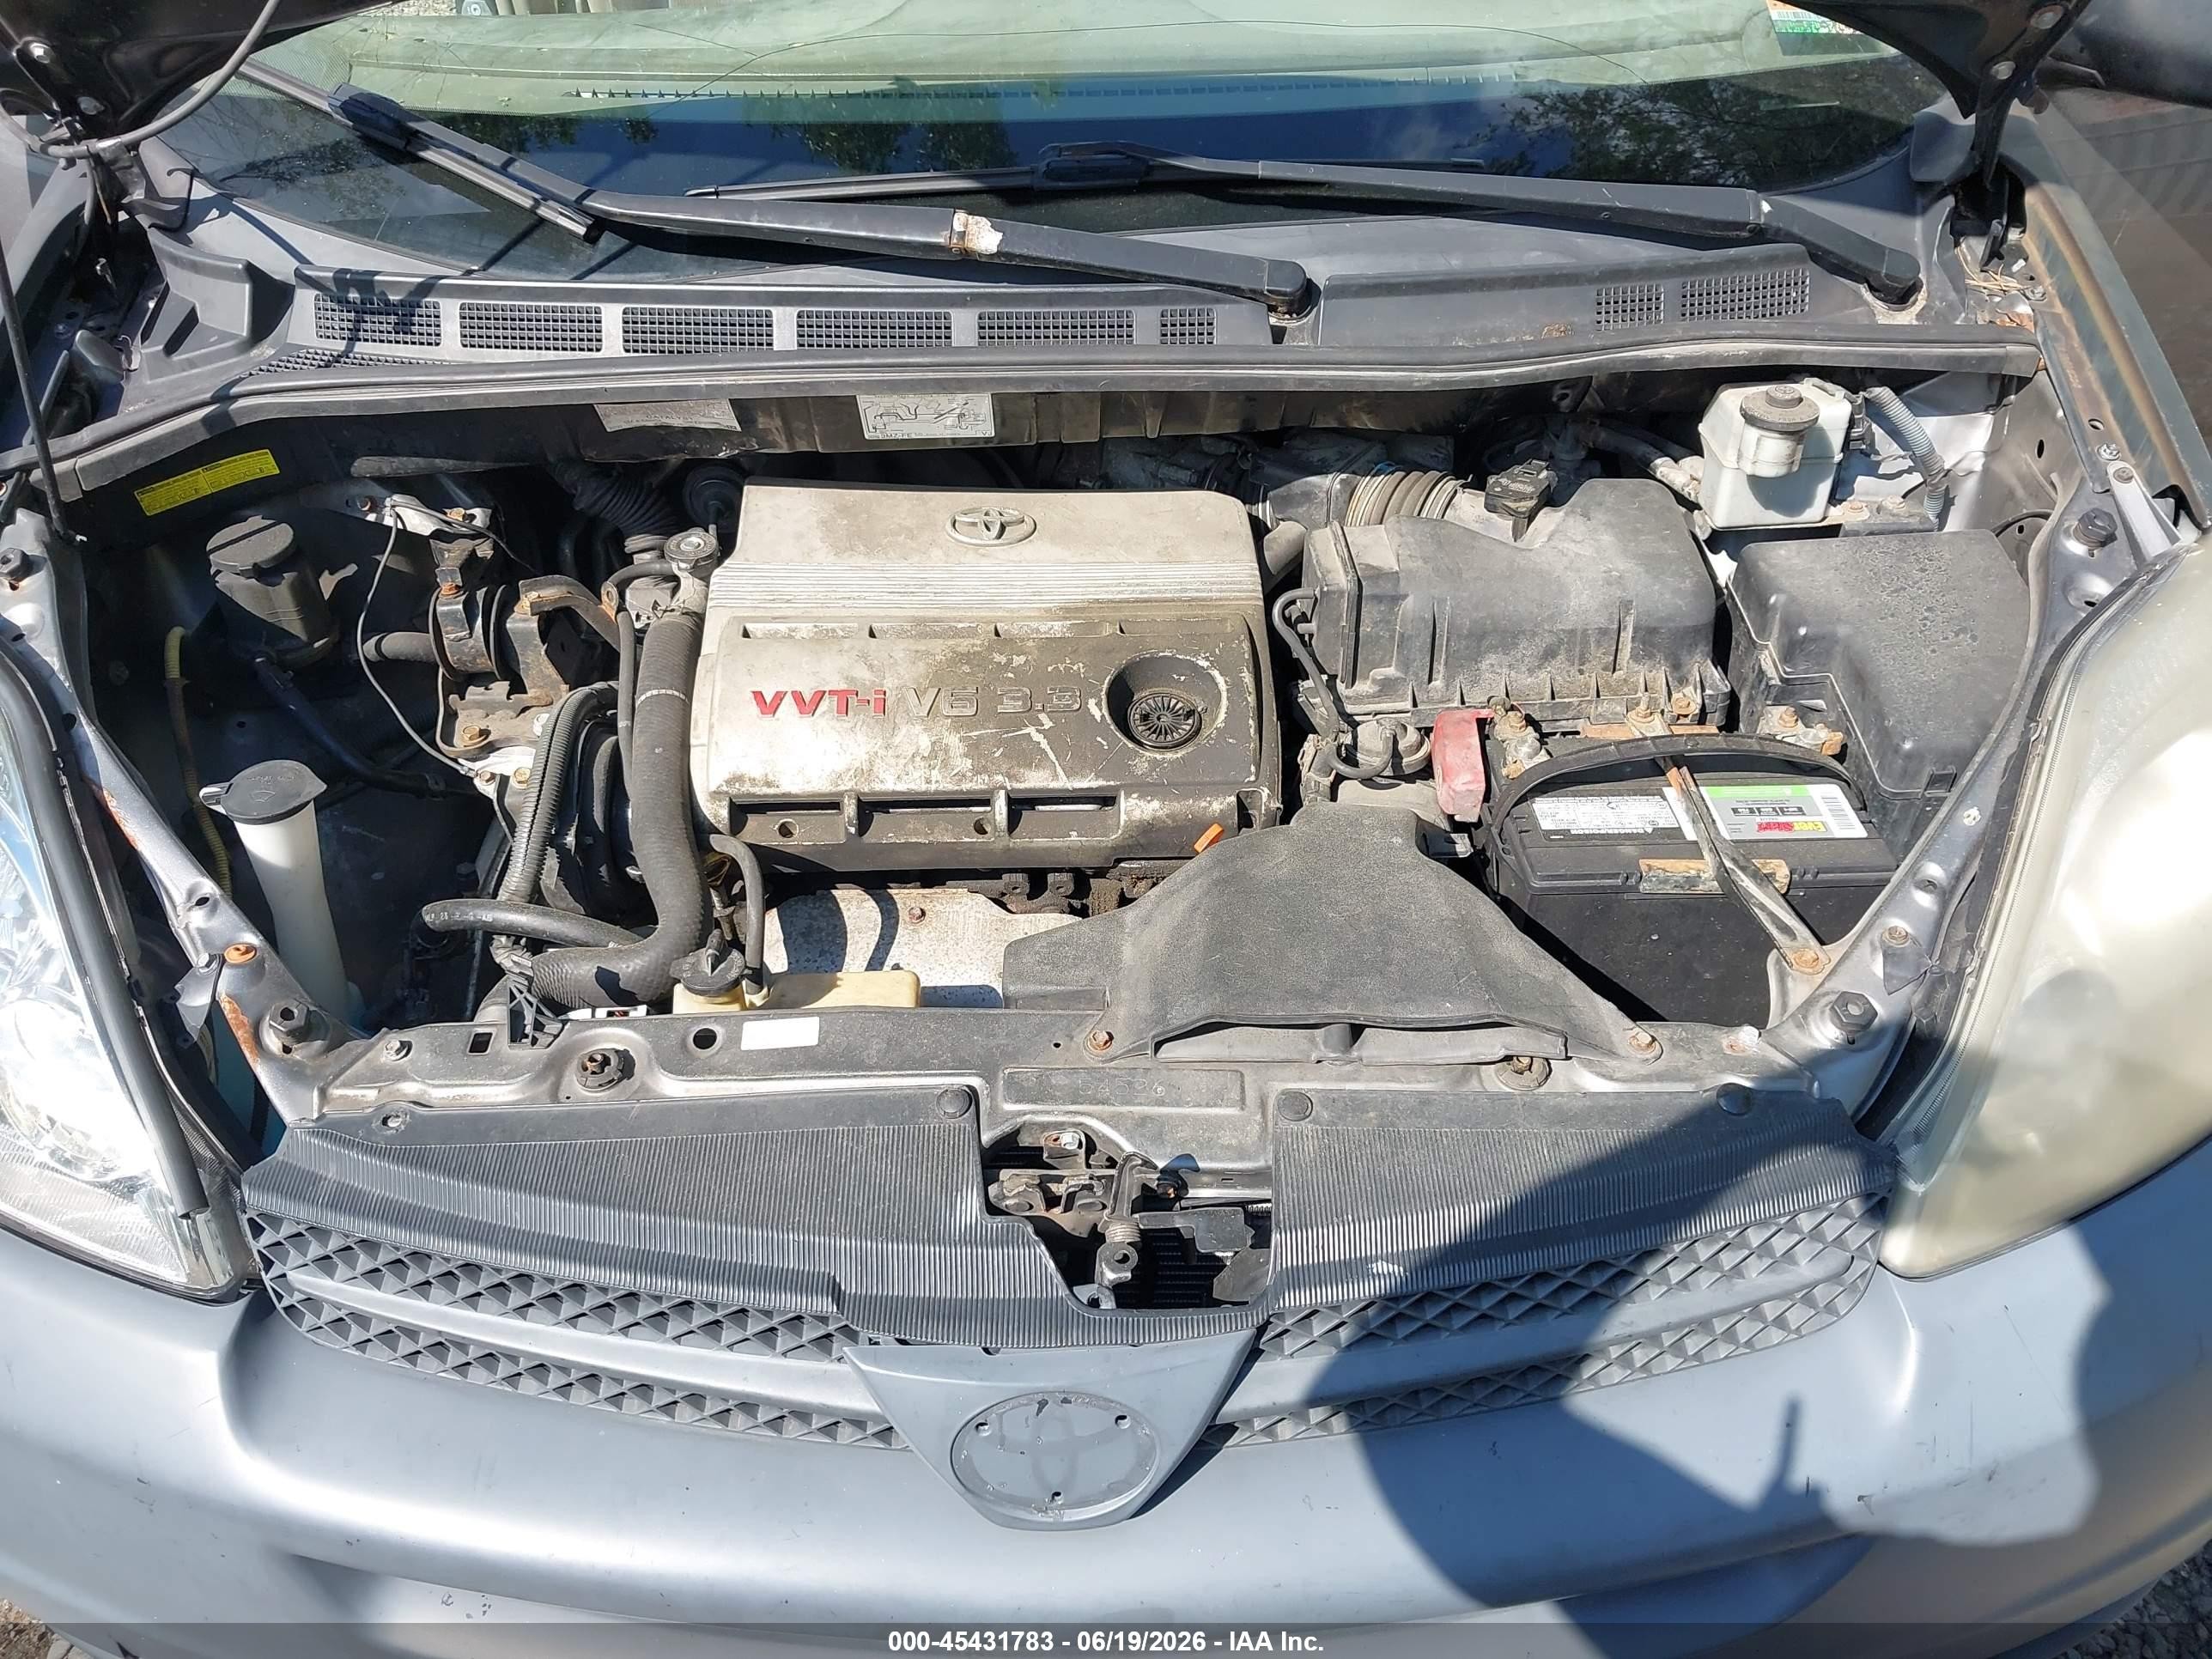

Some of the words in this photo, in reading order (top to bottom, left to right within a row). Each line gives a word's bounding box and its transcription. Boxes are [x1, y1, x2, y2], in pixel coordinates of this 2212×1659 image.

[750, 689, 887, 717] VVT-i
[902, 686, 980, 717] V6
[997, 685, 1083, 714] 3.3
